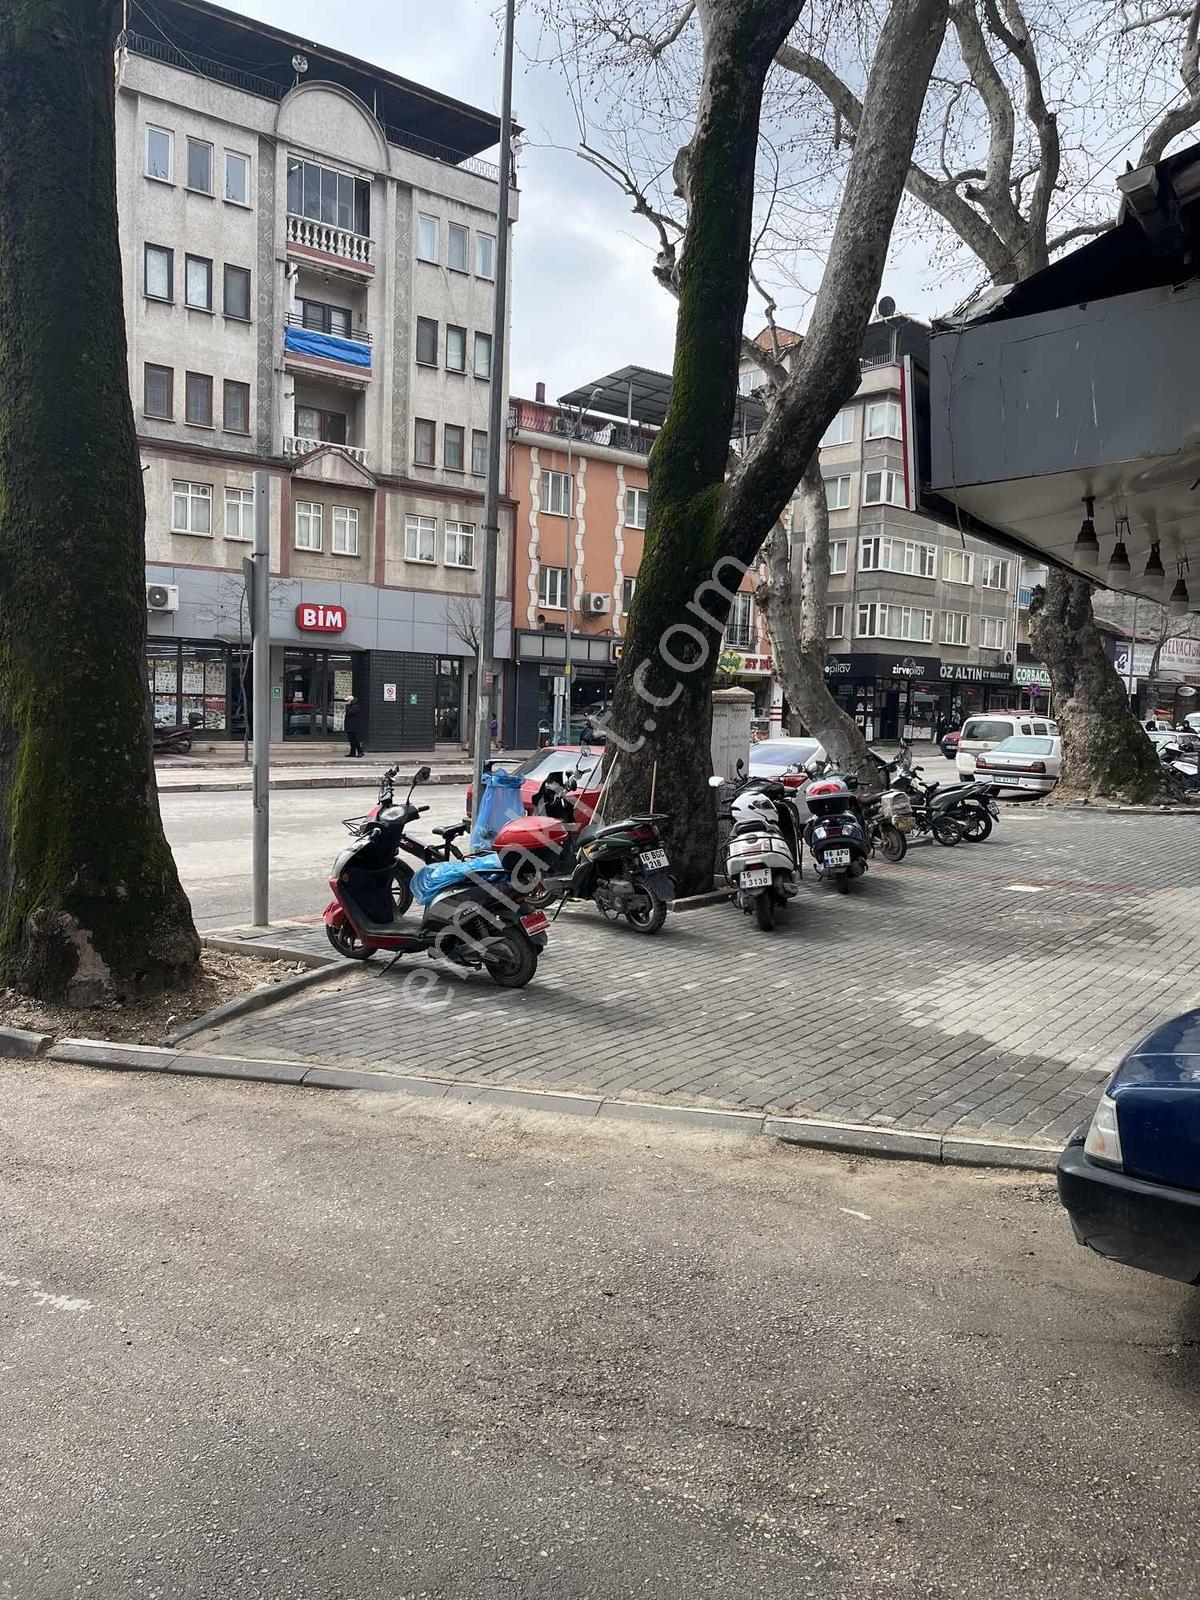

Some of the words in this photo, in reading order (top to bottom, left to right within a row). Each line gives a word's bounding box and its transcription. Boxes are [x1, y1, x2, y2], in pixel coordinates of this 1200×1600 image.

[303, 605, 343, 628] BİM
[954, 666, 983, 681] ALTIN
[641, 853, 650, 861] 16
[742, 871, 752, 879] 16
[748, 877, 768, 887] 3130
